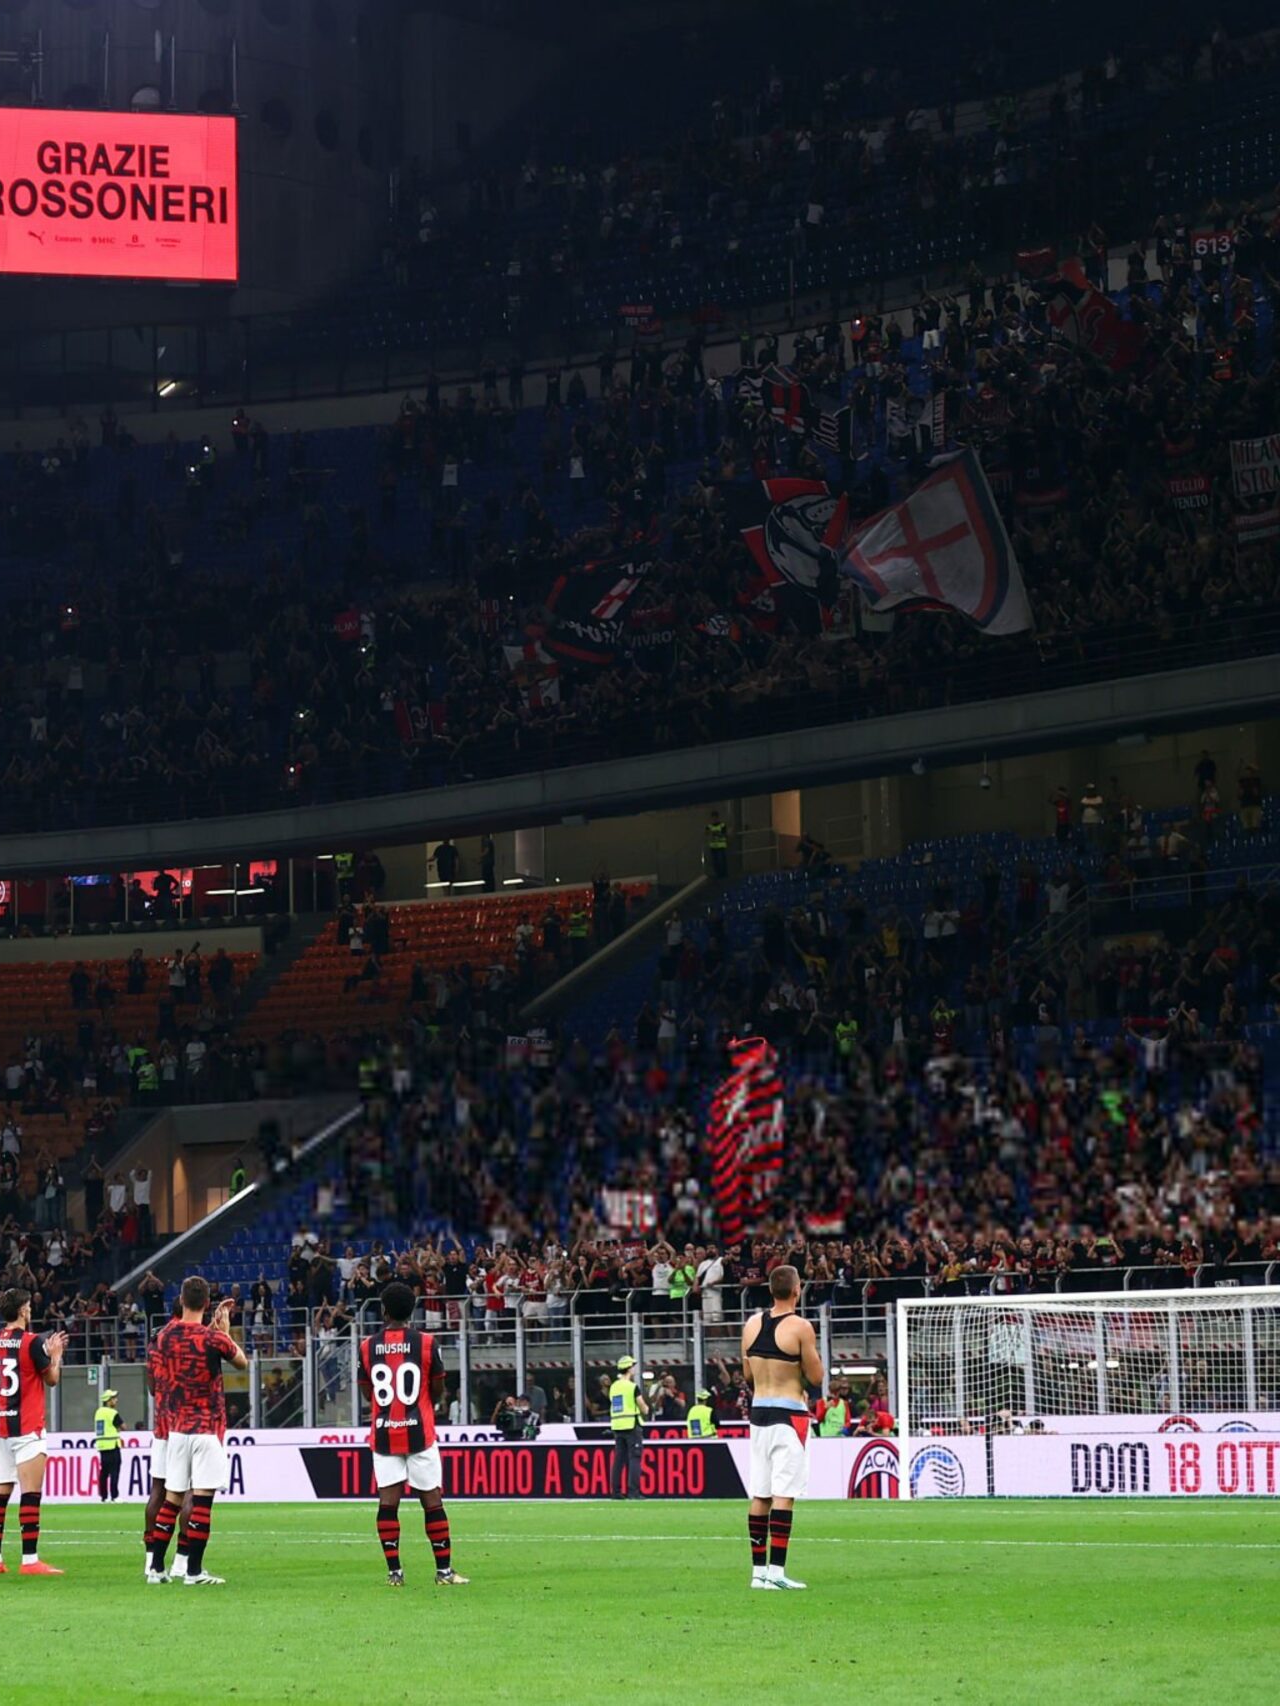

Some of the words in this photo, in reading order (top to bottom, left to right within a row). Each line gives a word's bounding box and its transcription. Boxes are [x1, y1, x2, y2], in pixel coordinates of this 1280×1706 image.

[37, 140, 170, 178] GRAZIE
[1195, 235, 1232, 254] 613
[375, 1343, 411, 1355] MUSAH
[370, 1362, 421, 1407] 80
[384, 1418, 418, 1428] bitpanda
[46, 1455, 110, 1497] MILA
[337, 1451, 360, 1495] TI
[544, 1449, 563, 1495] A
[640, 1447, 705, 1495] SIRO
[862, 1450, 898, 1475] ACM
[1070, 1441, 1150, 1493] DOM
[1164, 1441, 1200, 1493] 18
